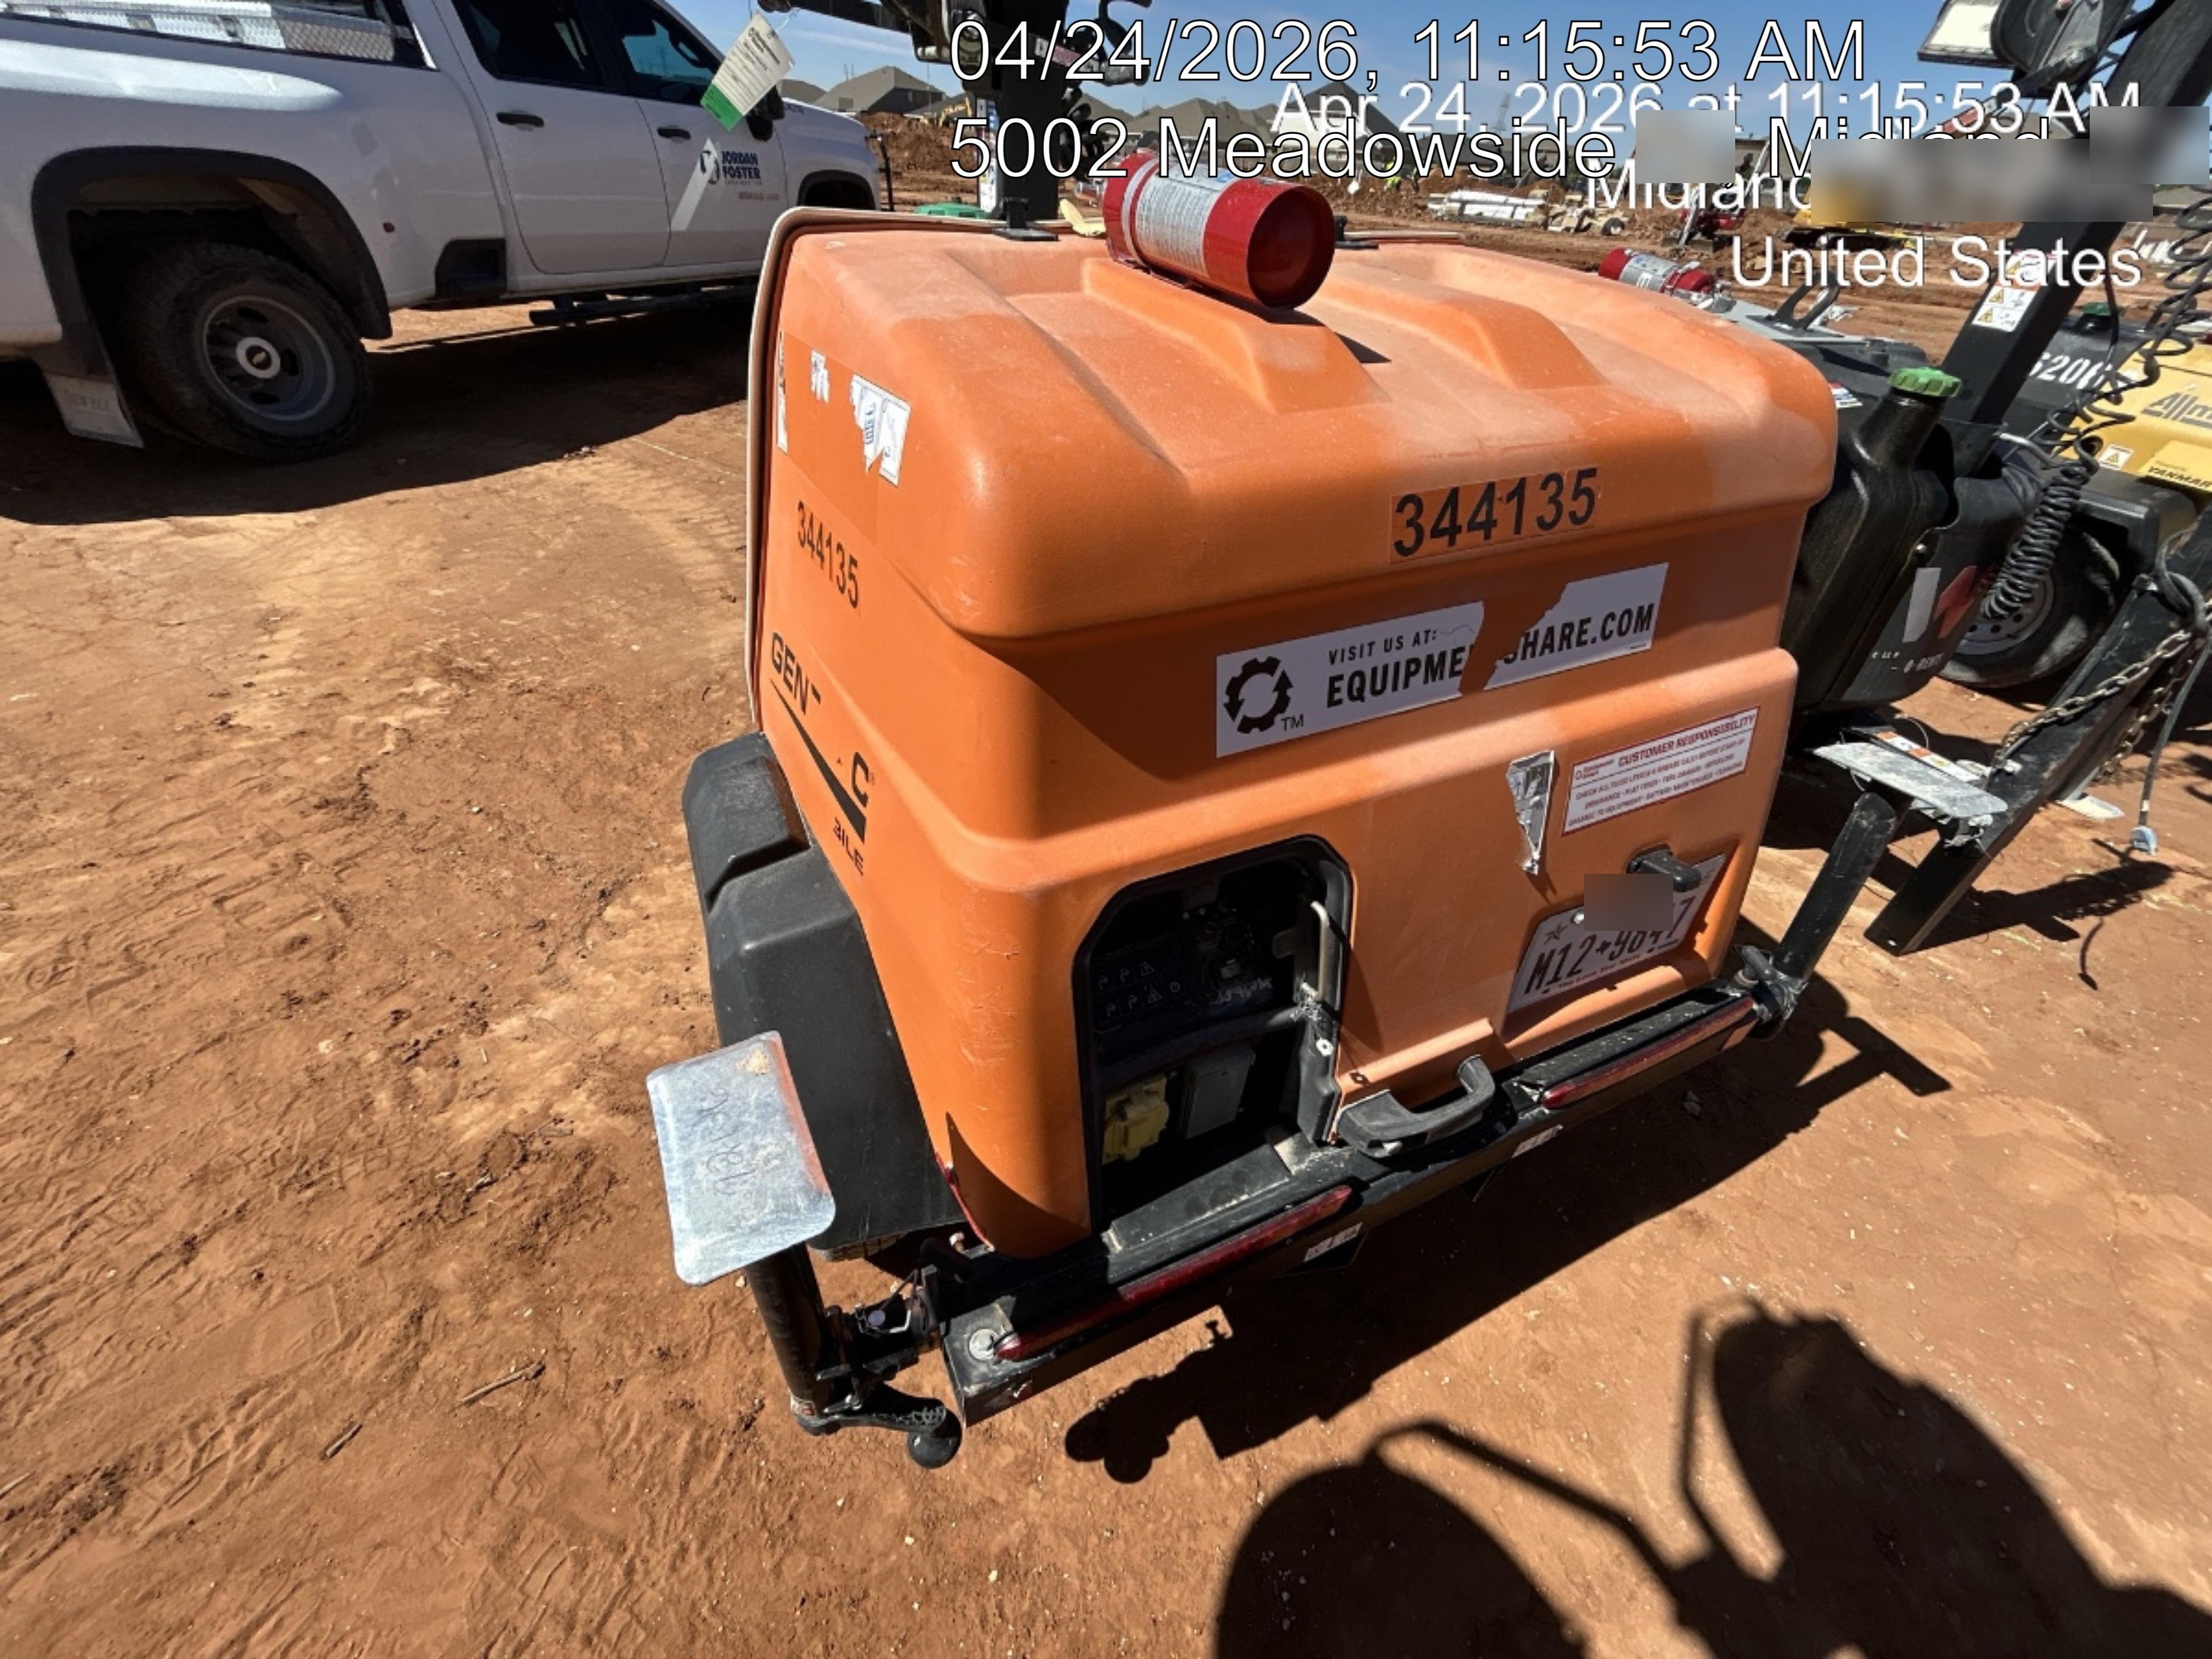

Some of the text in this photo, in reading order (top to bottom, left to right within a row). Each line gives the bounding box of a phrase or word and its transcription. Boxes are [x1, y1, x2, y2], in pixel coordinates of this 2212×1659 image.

[1394, 468, 1597, 557] 344135
[798, 501, 858, 609] 344135
[1328, 629, 1437, 665] VISIT US AT:
[1281, 713, 1304, 731] TM
[1618, 740, 1674, 767] CUSTOMER
